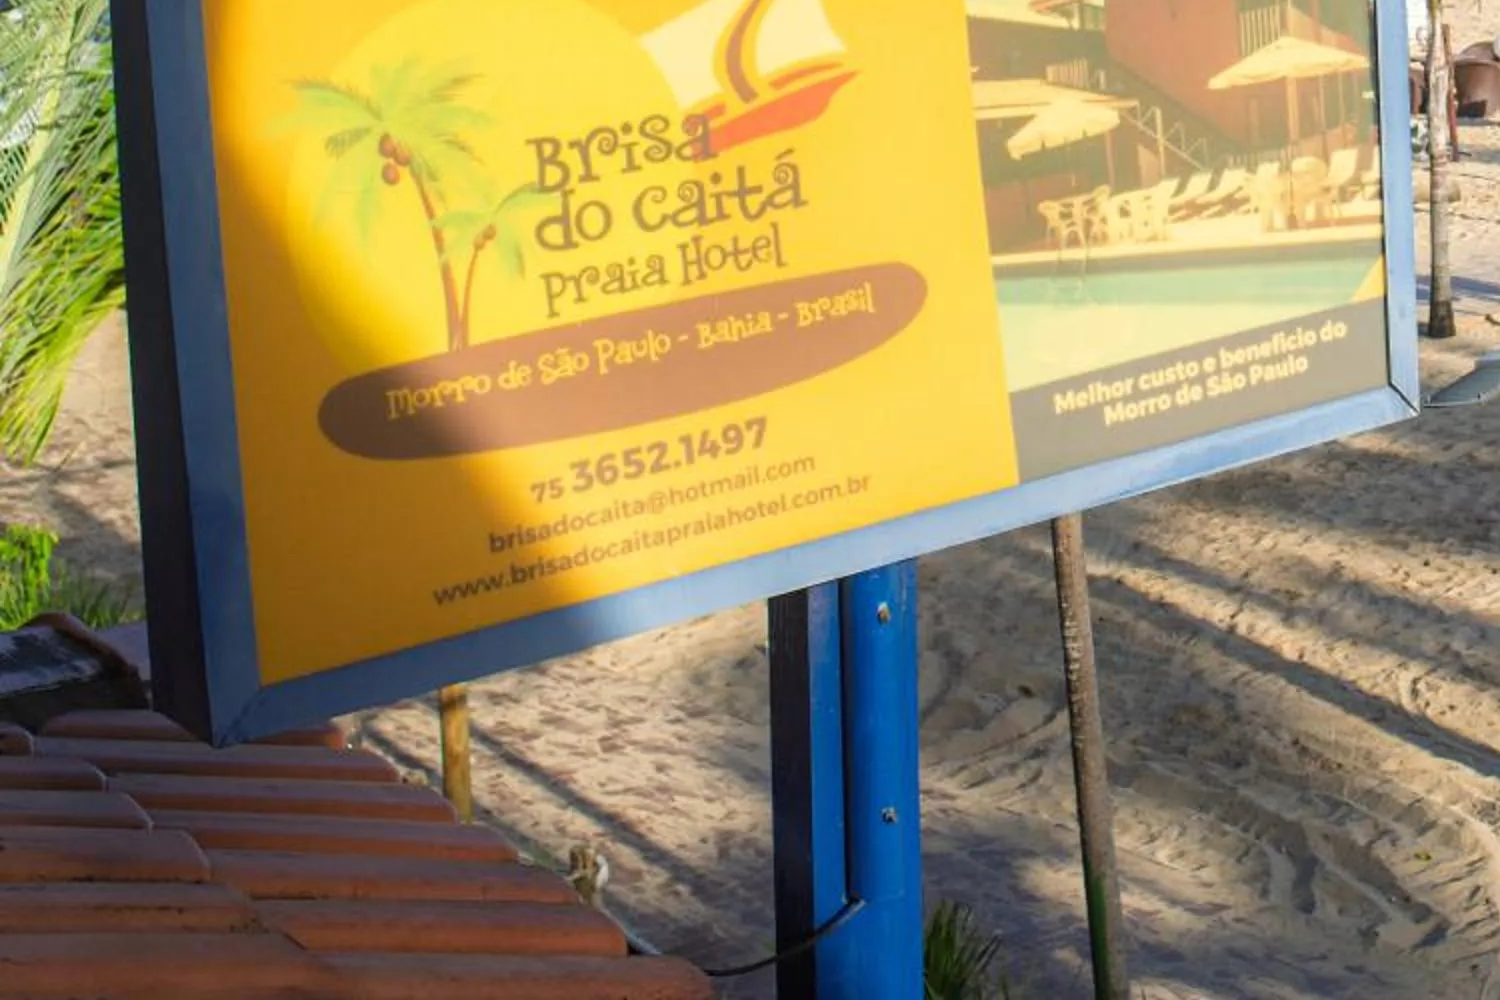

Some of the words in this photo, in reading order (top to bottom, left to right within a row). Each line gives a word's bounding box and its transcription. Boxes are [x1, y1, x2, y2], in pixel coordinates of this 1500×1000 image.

[525, 114, 719, 194] Brisa
[534, 188, 613, 252] do
[676, 222, 787, 286] Hotel
[498, 360, 532, 389] de
[537, 348, 590, 385] São
[593, 328, 671, 375] Paulo
[696, 312, 772, 350] Bahia
[794, 281, 876, 328] Brasil
[1053, 377, 1135, 415] Melhor
[1138, 359, 1200, 391] custo
[1203, 355, 1219, 373] e
[1319, 319, 1348, 342] do
[1103, 396, 1172, 425] Morro
[1175, 382, 1204, 407] de
[1206, 368, 1248, 398] São
[1250, 354, 1309, 386] Paulo
[530, 481, 564, 503] 75
[569, 416, 768, 492] 3652.1497
[432, 475, 872, 605] www.brisadocaitapraiahotel.com.br
[489, 456, 816, 554] brisadocaita@hotmail.com
